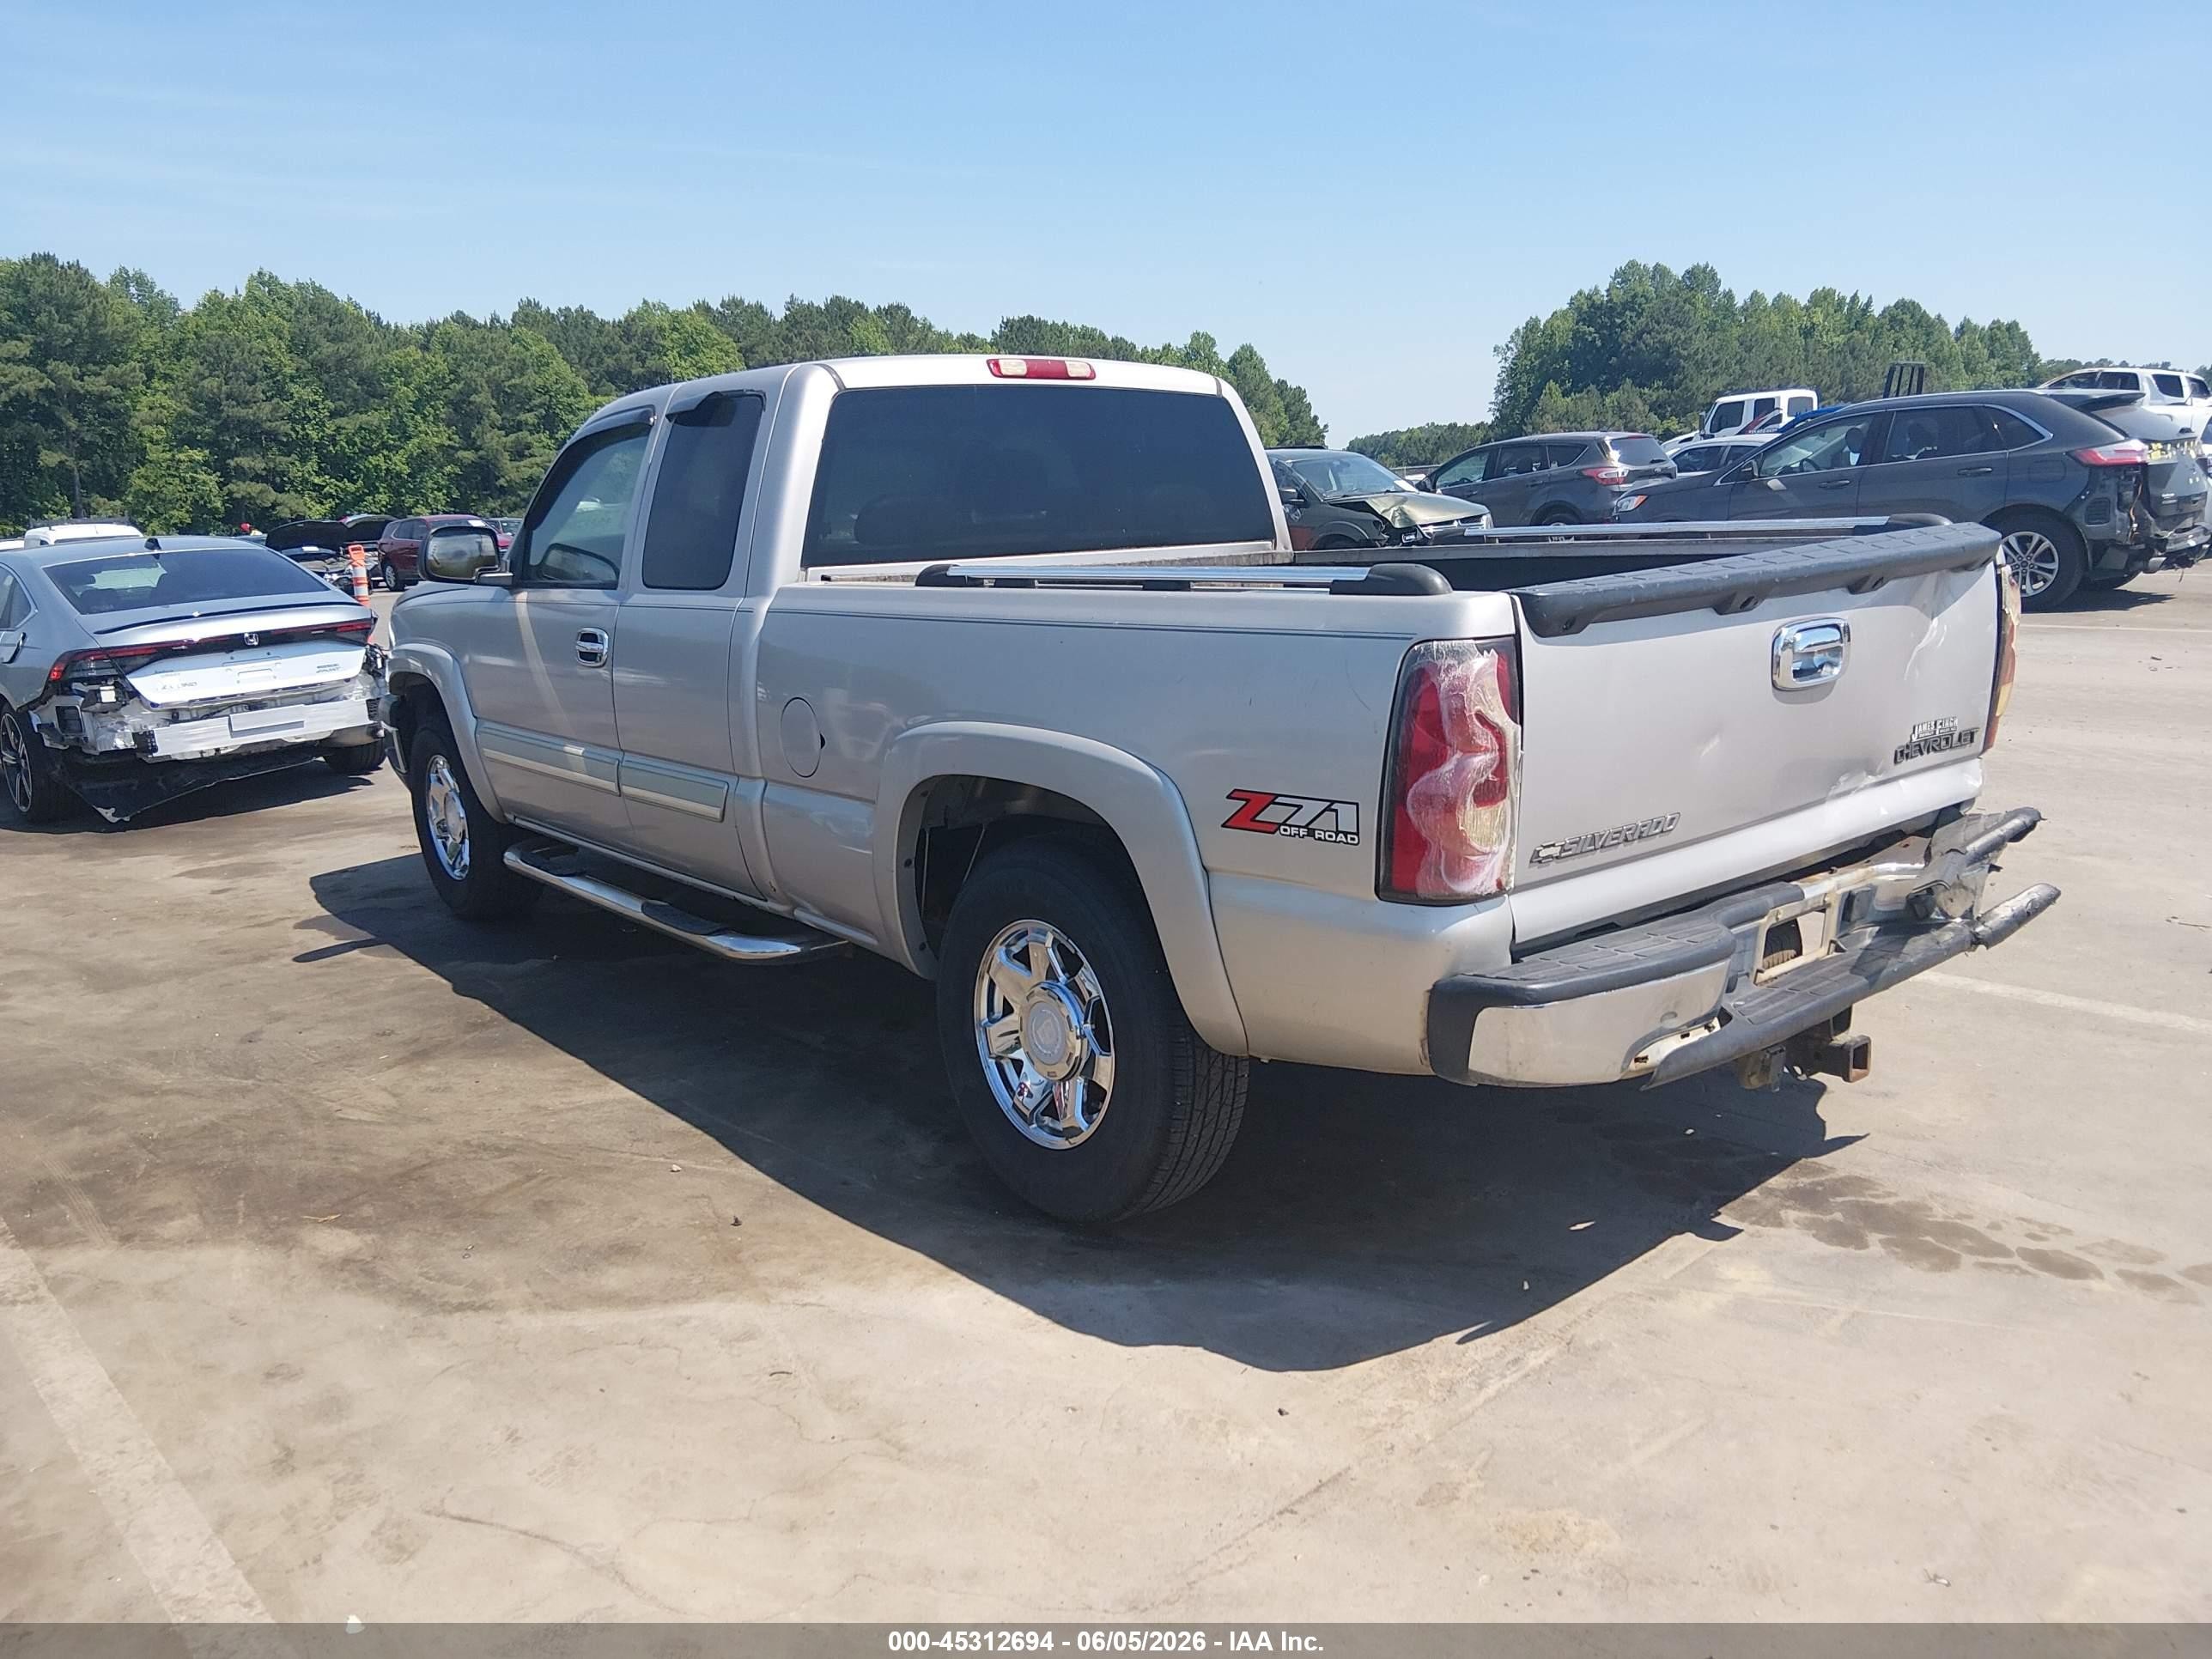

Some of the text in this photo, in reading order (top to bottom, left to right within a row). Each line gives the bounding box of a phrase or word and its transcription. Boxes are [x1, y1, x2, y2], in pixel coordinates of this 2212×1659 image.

[1893, 727, 1979, 764] CHEVROLET
[1221, 788, 1359, 834] Z71
[1279, 825, 1359, 844] OFF ROAD
[1561, 812, 1680, 858] SILVERADO
